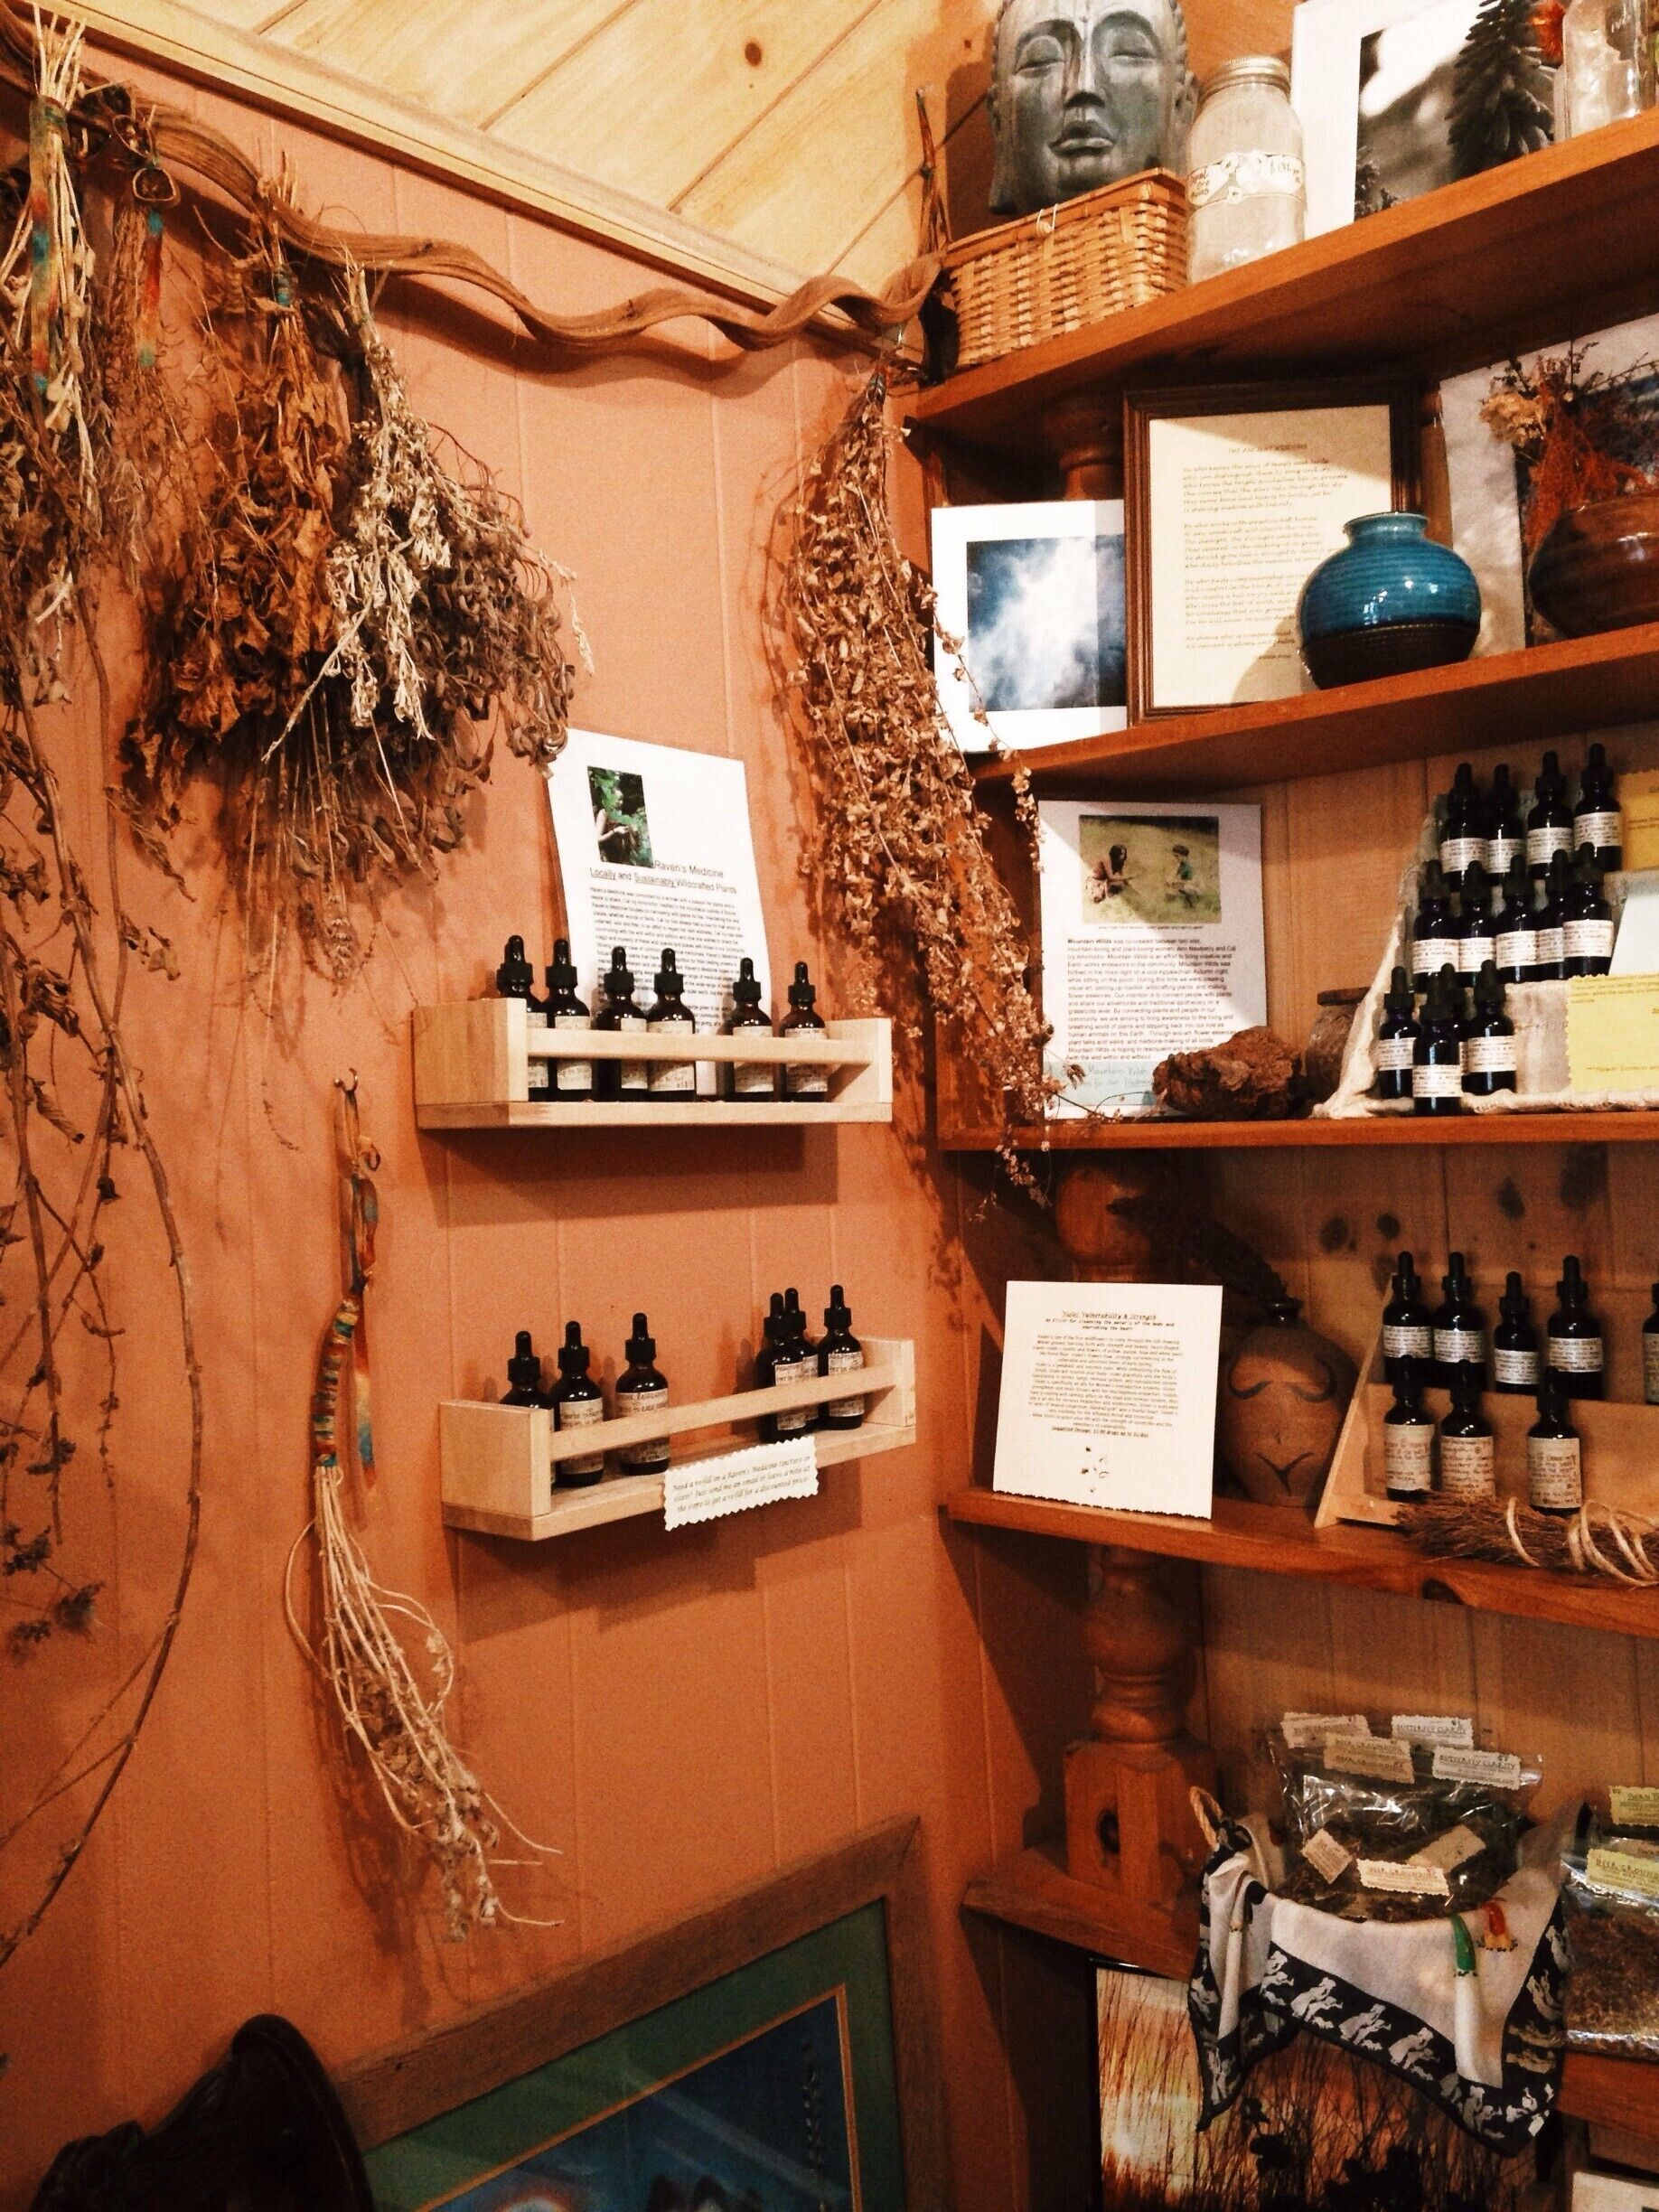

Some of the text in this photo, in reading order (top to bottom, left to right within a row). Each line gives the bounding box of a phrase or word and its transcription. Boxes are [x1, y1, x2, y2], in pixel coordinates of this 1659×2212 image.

[654, 860, 724, 878] Raven's Medicine
[590, 867, 737, 894] Locally and Sustainably Wildcrafted Plants
